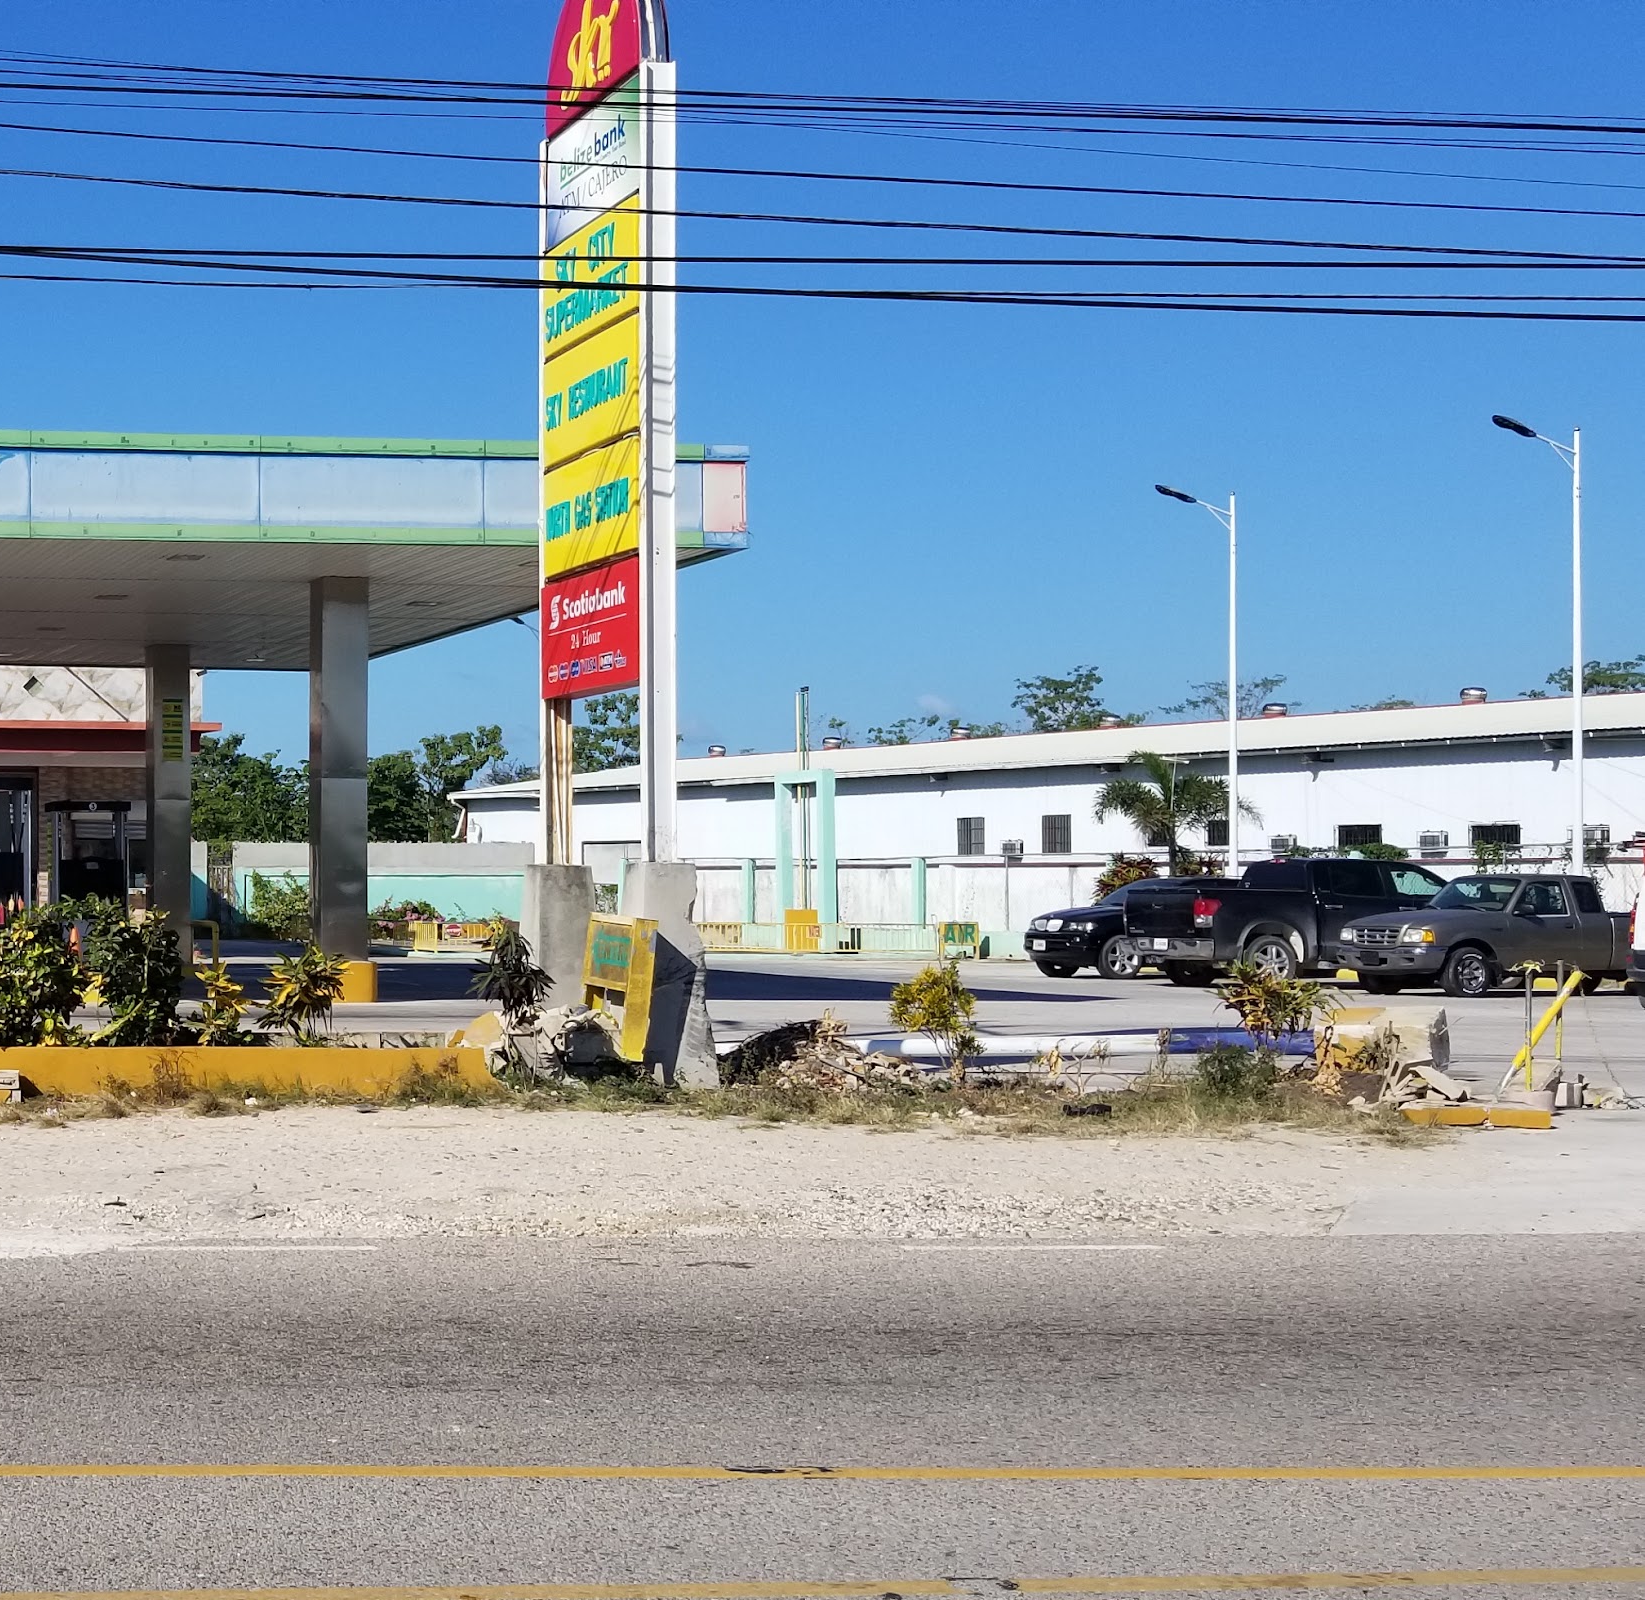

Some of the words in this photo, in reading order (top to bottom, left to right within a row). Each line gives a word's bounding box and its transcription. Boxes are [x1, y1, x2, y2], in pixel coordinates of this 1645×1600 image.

[559, 186, 580, 219] ATM
[588, 155, 628, 197] CAJERO
[587, 221, 615, 273] CITY
[545, 391, 562, 432] SKY
[575, 490, 592, 531] GAS
[562, 580, 626, 621] Scotiabank
[570, 632, 580, 650] 24
[582, 630, 601, 648] Hour
[944, 924, 976, 944] AIR
